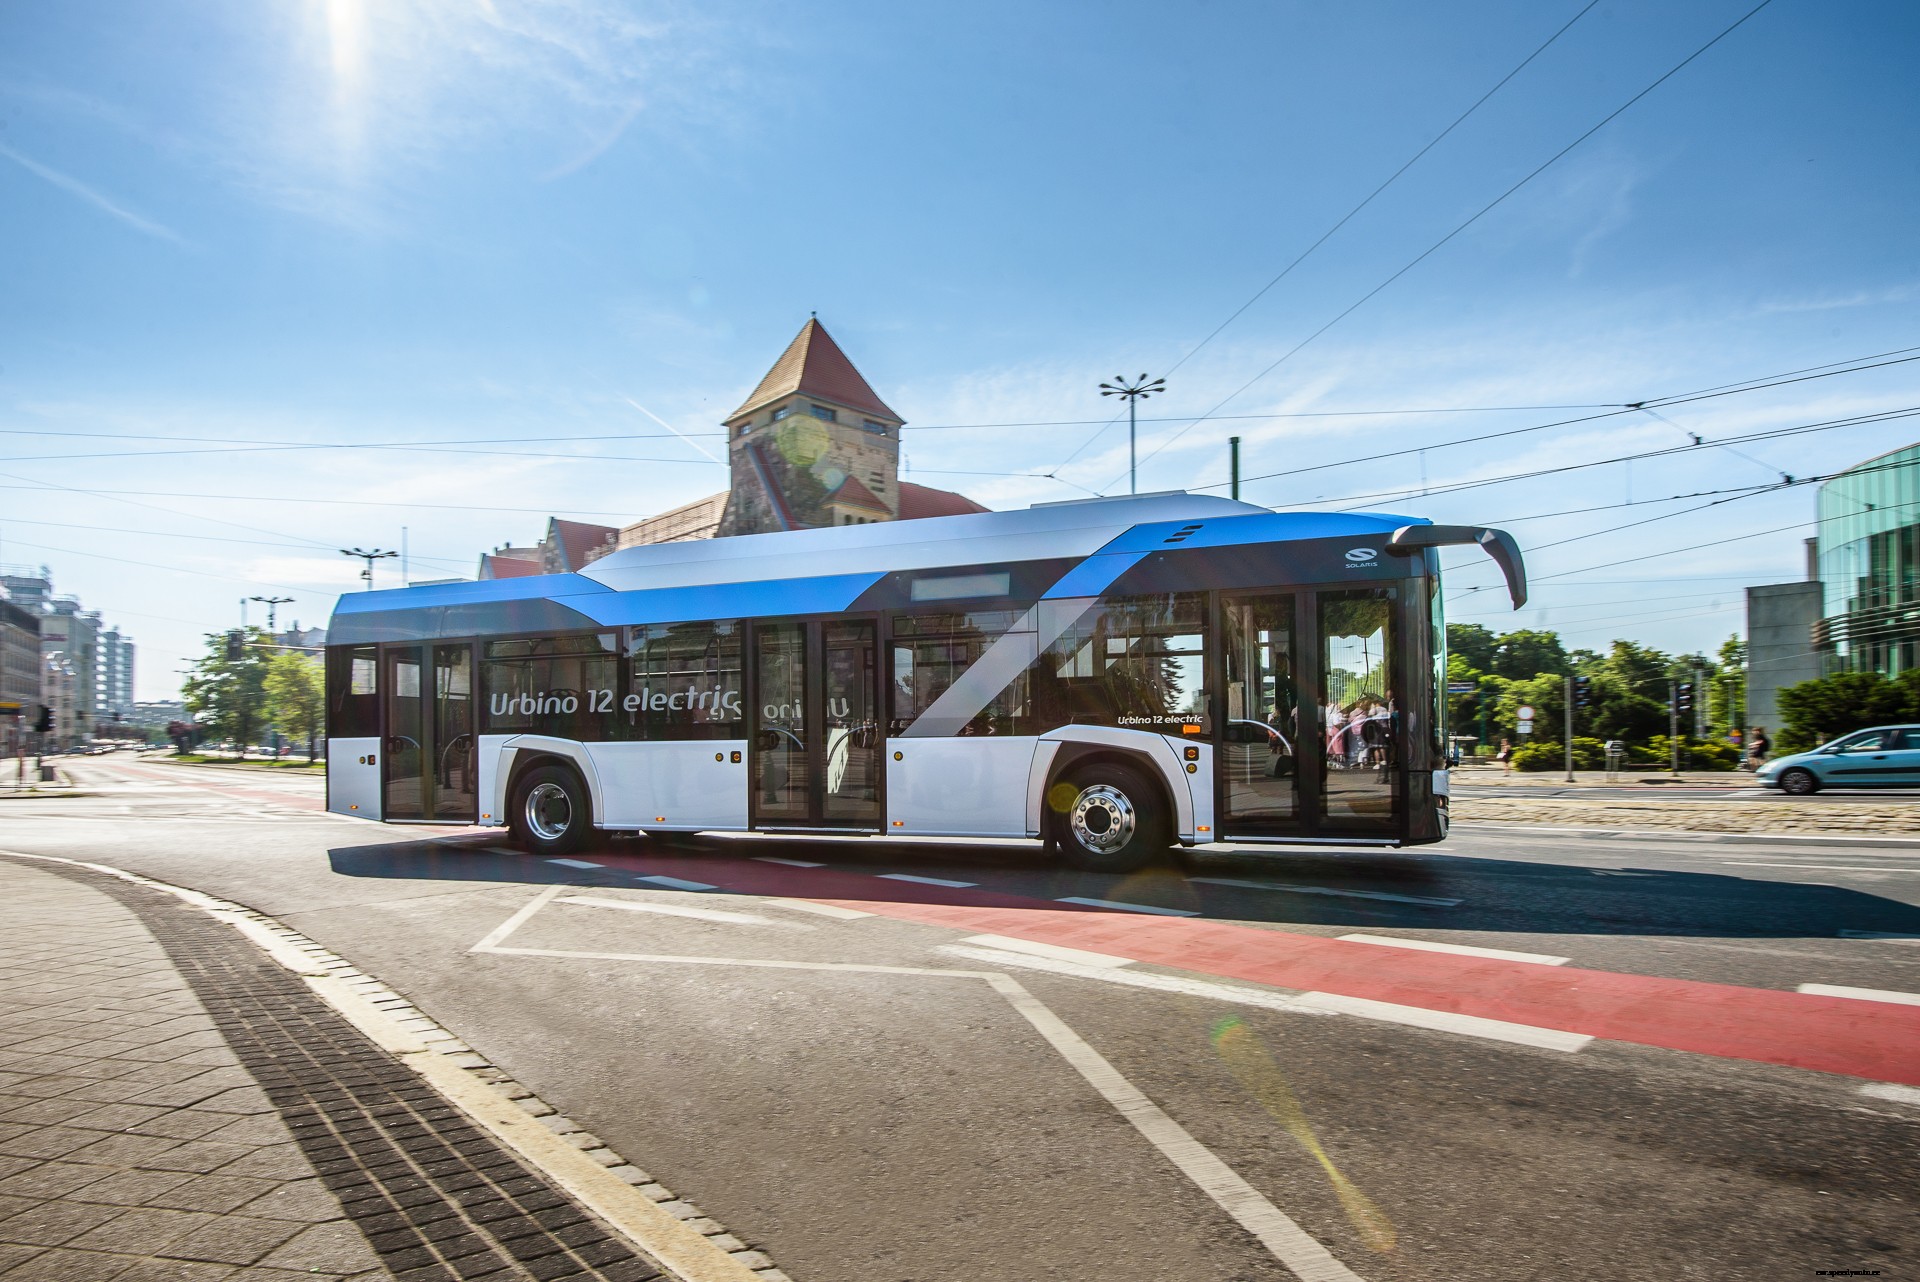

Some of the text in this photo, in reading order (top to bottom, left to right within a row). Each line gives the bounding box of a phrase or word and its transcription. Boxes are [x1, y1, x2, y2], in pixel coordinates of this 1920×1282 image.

[1345, 561, 1378, 569] SOLARIS
[490, 692, 578, 716] Urbino
[587, 690, 613, 713] 12
[622, 684, 739, 713] electric
[1118, 714, 1203, 725] Urbino 12 electric
